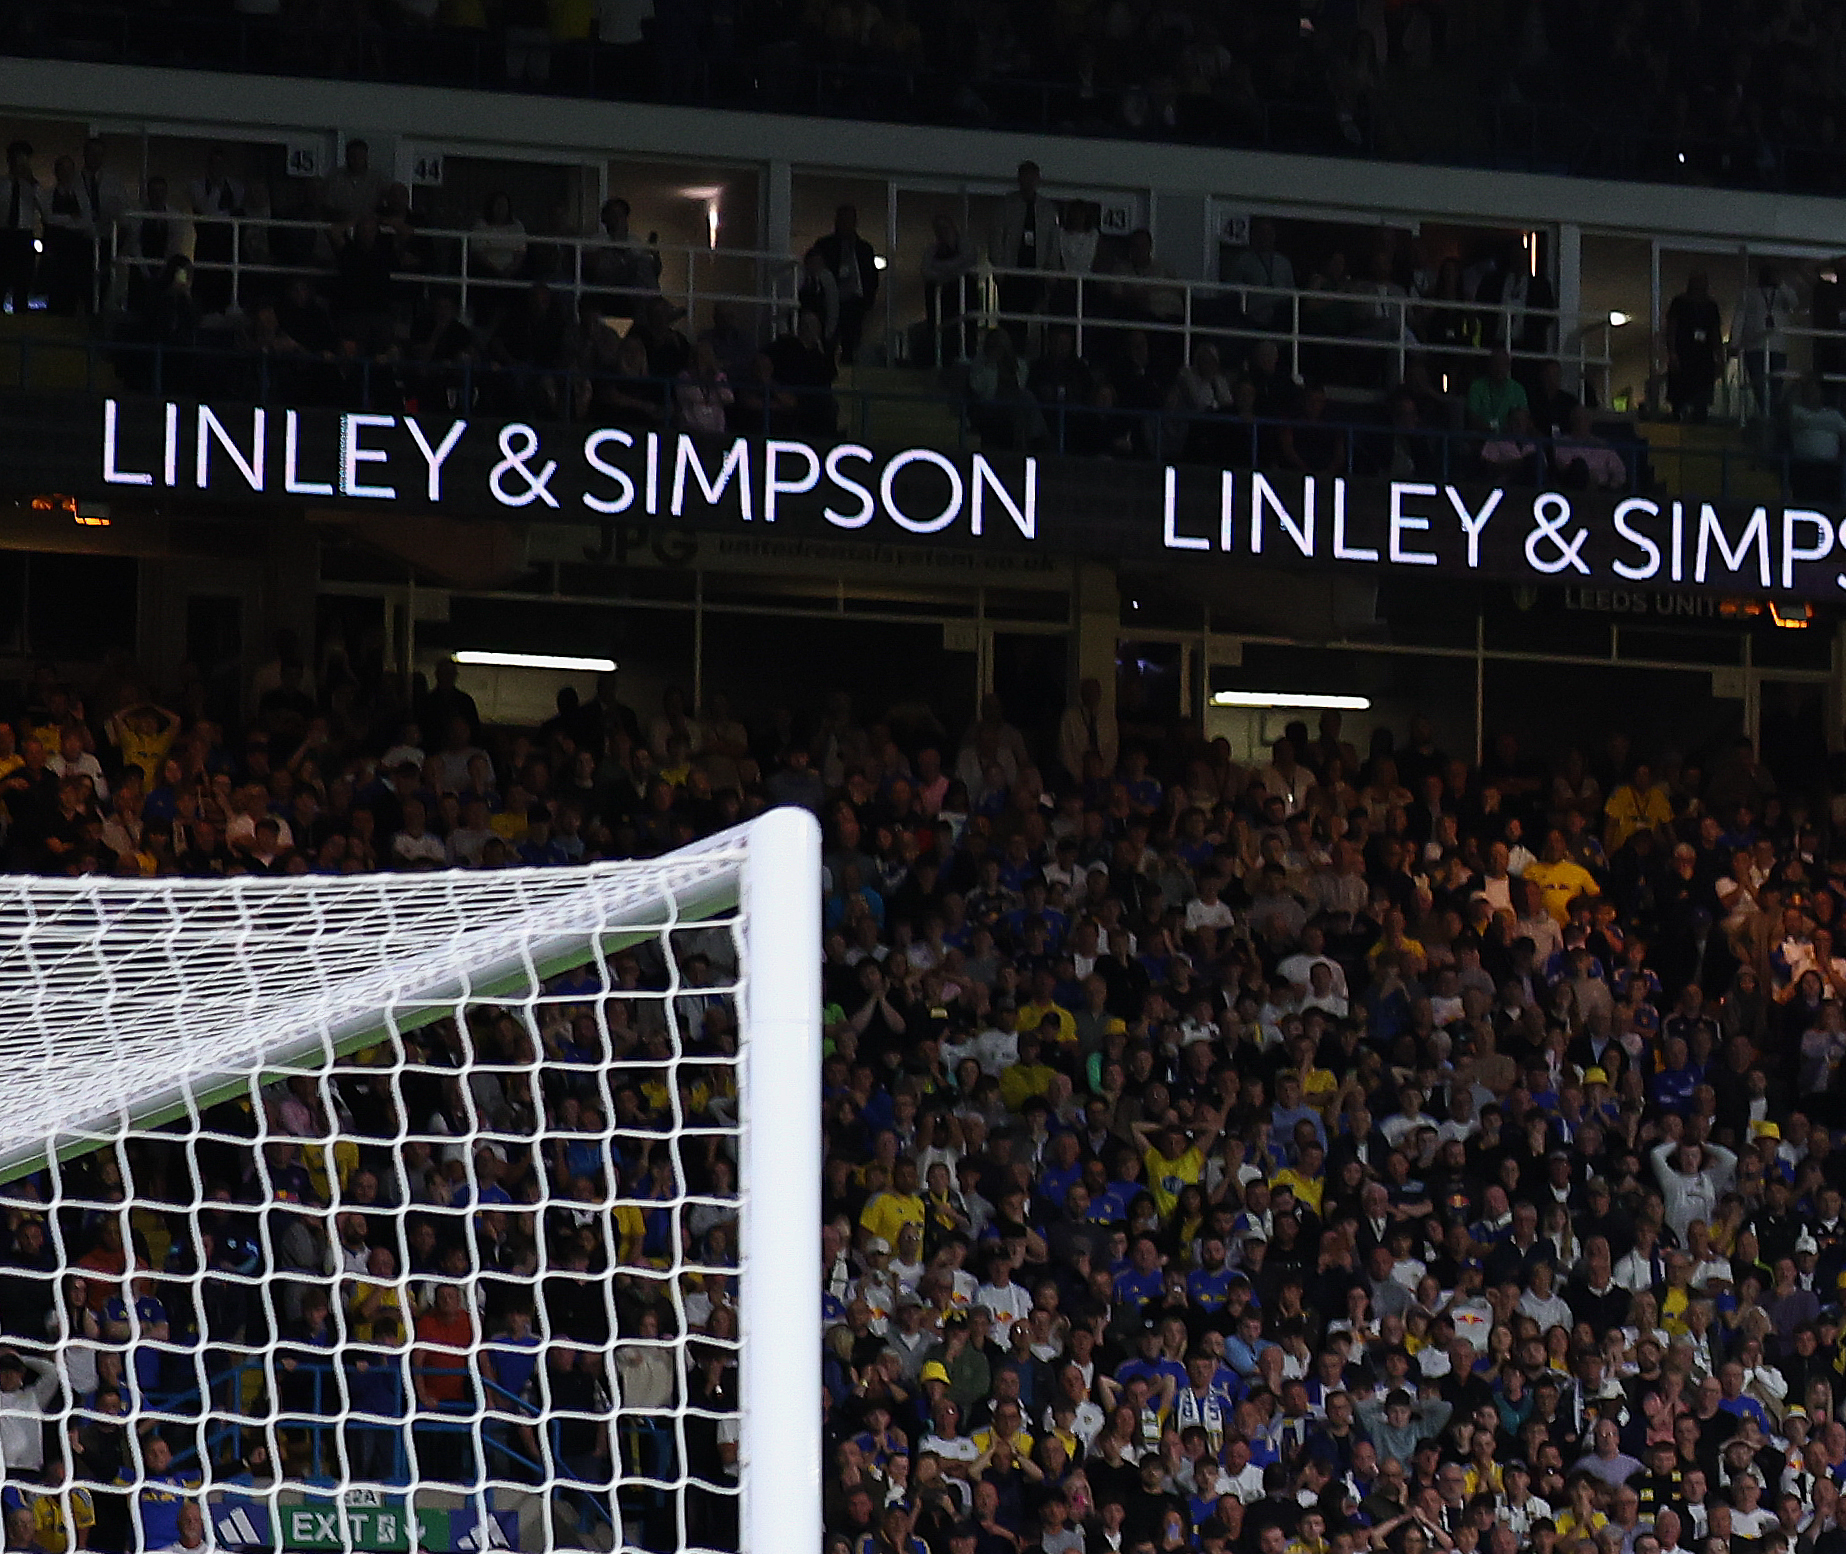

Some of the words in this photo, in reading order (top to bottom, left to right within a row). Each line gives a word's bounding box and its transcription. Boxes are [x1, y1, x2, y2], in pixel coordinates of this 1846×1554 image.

[102, 398, 467, 502] LINLEY
[488, 423, 561, 509] &
[581, 428, 1038, 540] SIMPSON
[1163, 465, 1504, 569] LINLEY
[1524, 492, 1591, 575] &
[582, 522, 699, 563] JPG
[1565, 584, 1647, 613] LEEDS
[291, 1511, 370, 1544] EXT
